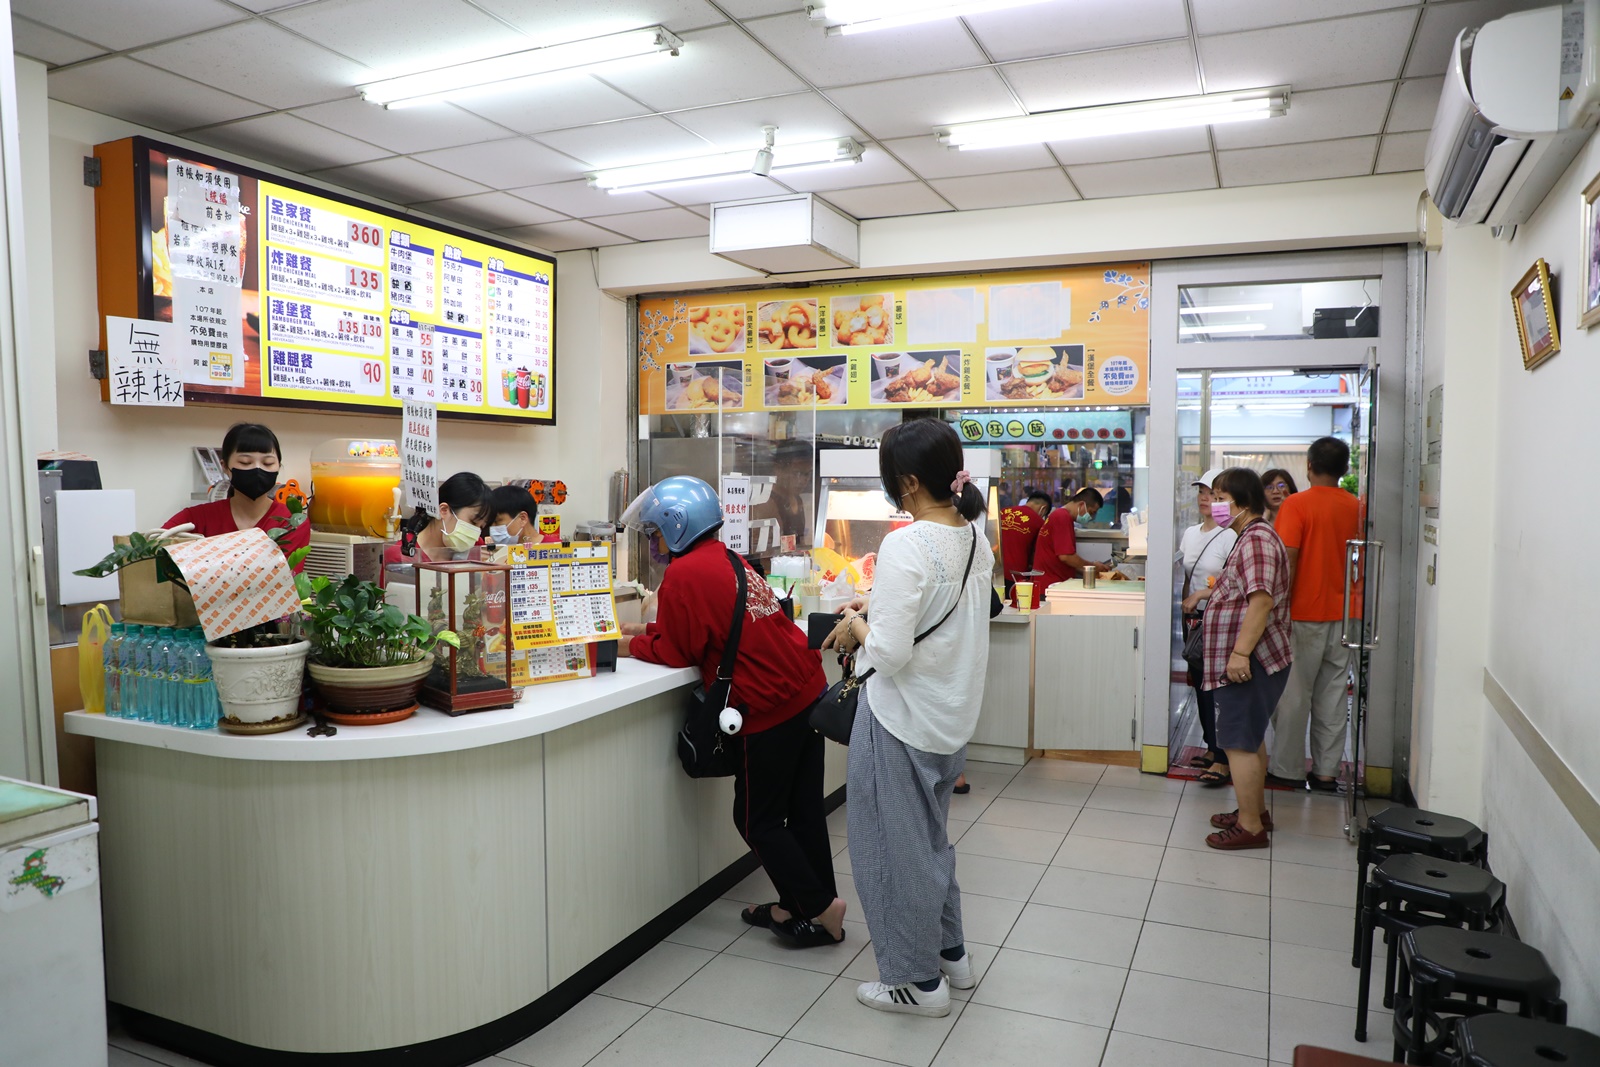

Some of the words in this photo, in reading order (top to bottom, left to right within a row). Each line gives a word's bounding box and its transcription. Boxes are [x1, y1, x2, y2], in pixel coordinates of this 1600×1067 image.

[176, 165, 231, 189] 結帳如須使用
[205, 189, 228, 205] 統編
[271, 199, 311, 223] 全家餐
[283, 216, 303, 228] CHICKEN
[304, 221, 317, 231] MEAL
[351, 223, 380, 246] 360
[187, 255, 226, 272] 將收取1元
[271, 249, 312, 272] 炸雞餐
[390, 247, 412, 261] 牛肉堡
[426, 257, 433, 266] 60
[283, 266, 303, 277] CHICKEN
[304, 271, 317, 279] MEAL
[390, 262, 412, 275] 雞肉堡
[426, 271, 433, 280] 55
[443, 260, 463, 273] 巧克力
[349, 268, 378, 290] 135
[497, 274, 518, 286] 可口可樂
[200, 286, 214, 295] 本店
[426, 285, 433, 294] 55
[390, 291, 412, 304] 豬肉堡
[426, 300, 433, 308] 55
[272, 300, 312, 320] 漢堡餐
[272, 315, 302, 325] HAMBURGER
[190, 325, 229, 339] 不免費提供
[339, 320, 359, 334] 135
[362, 324, 382, 337] 130
[129, 323, 163, 365] 無
[420, 333, 432, 346] 55
[272, 350, 313, 369] 雞腿餐
[421, 350, 433, 365] 55
[272, 365, 294, 373] CHICKEN
[363, 362, 381, 384] 90
[422, 368, 433, 384] 40
[115, 366, 182, 403] 辣椒
[470, 380, 482, 393] 30
[427, 389, 434, 397] 40
[443, 391, 468, 401] 小餐包
[475, 394, 482, 402] 25
[725, 504, 747, 514] 現金支付
